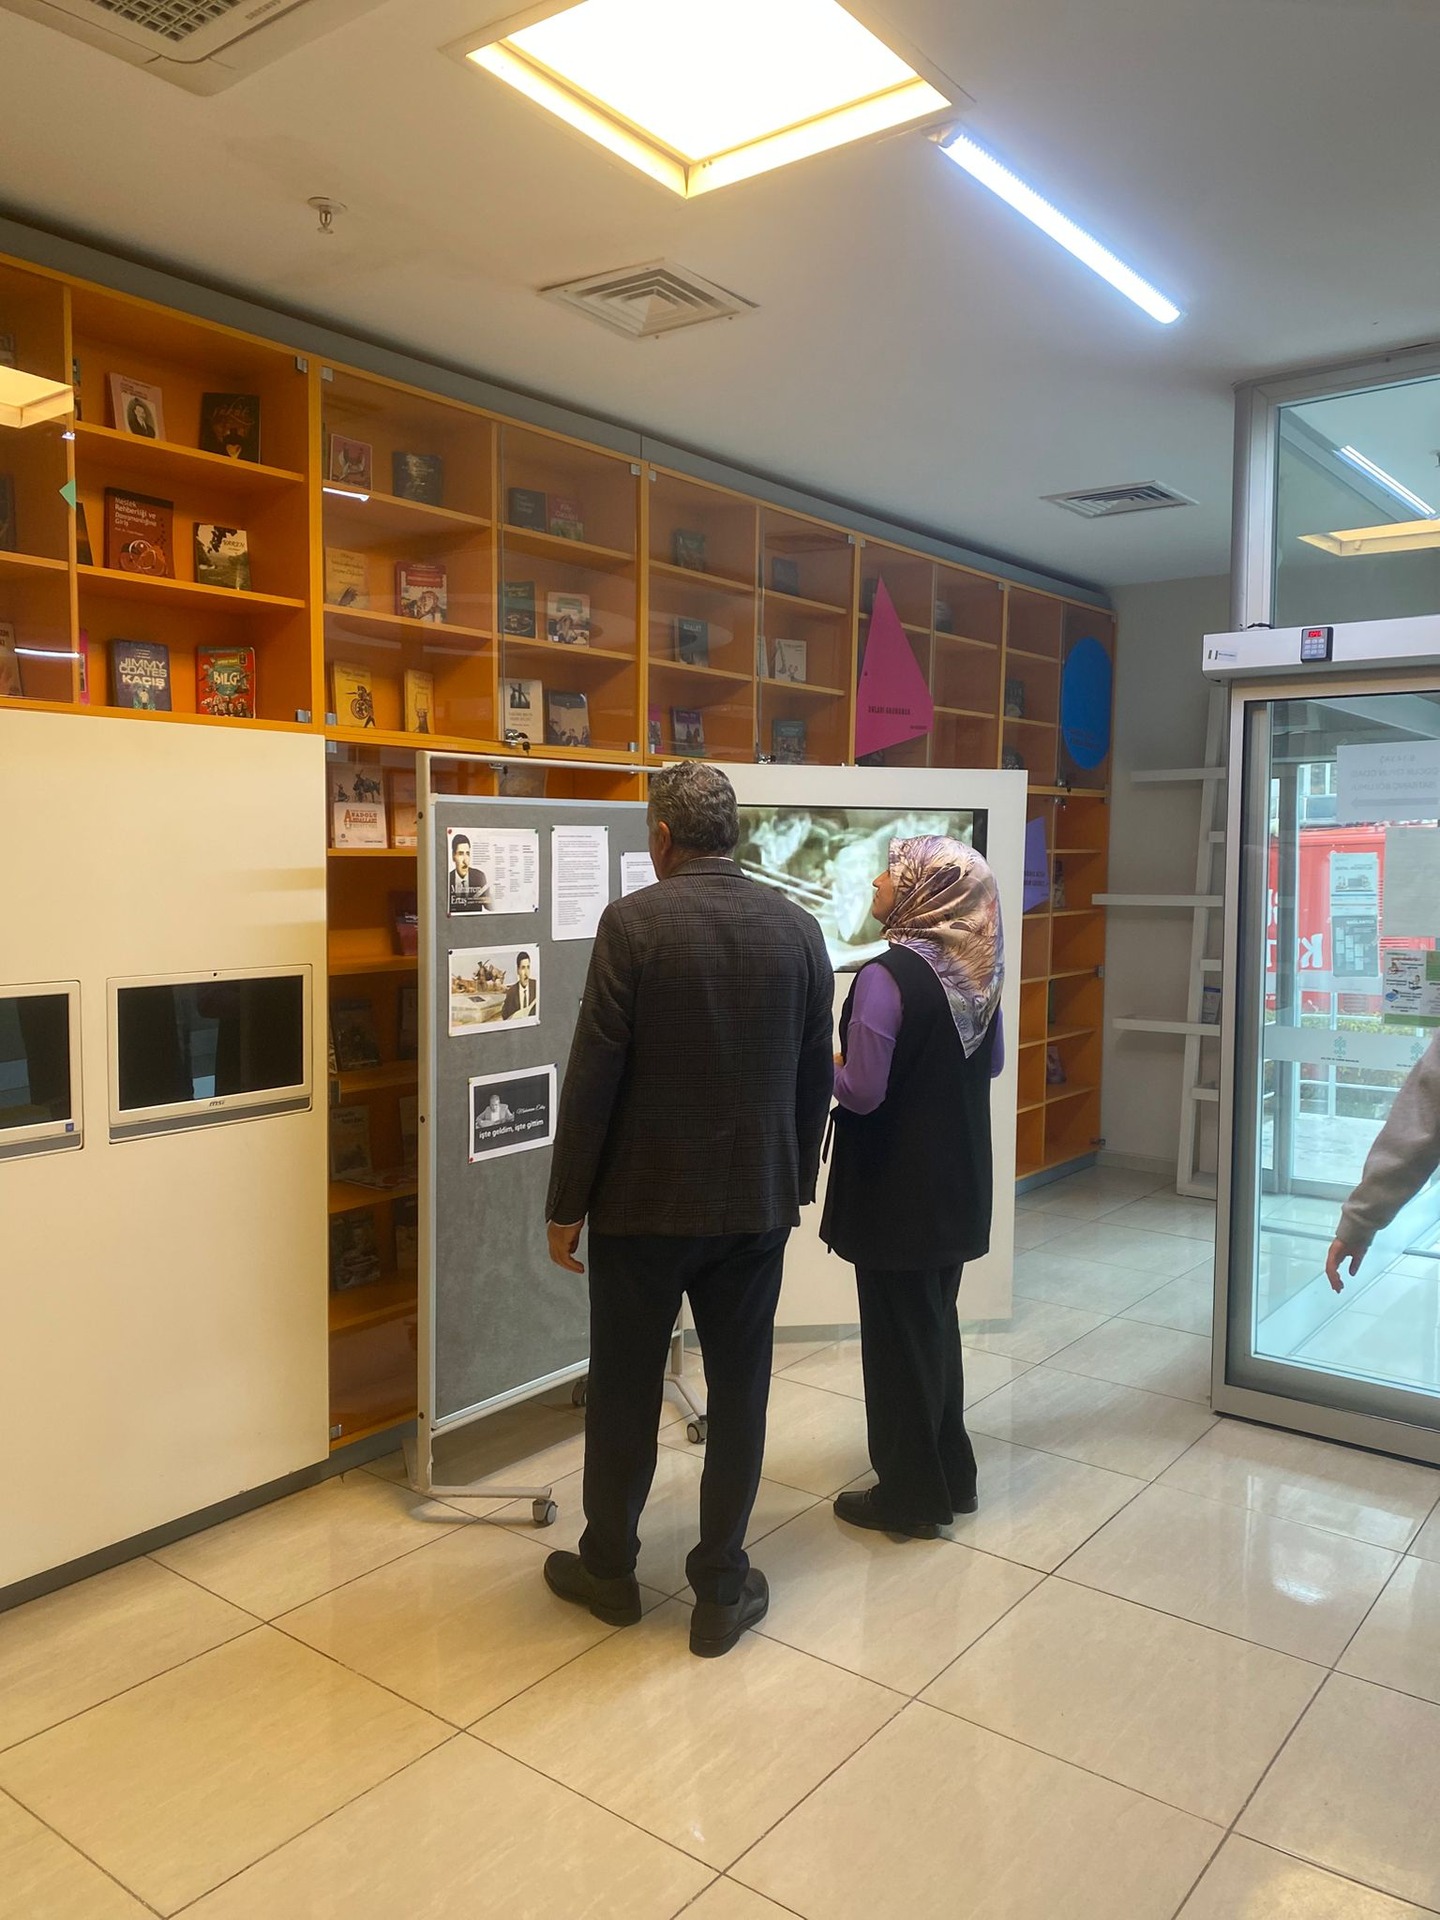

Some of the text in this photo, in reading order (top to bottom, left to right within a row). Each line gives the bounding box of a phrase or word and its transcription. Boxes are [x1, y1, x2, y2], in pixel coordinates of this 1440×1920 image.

[119, 664, 167, 678] COATES
[120, 657, 166, 671] JIMMY
[122, 674, 166, 690] KAÇIŞ
[527, 1119, 544, 1130] gittim
